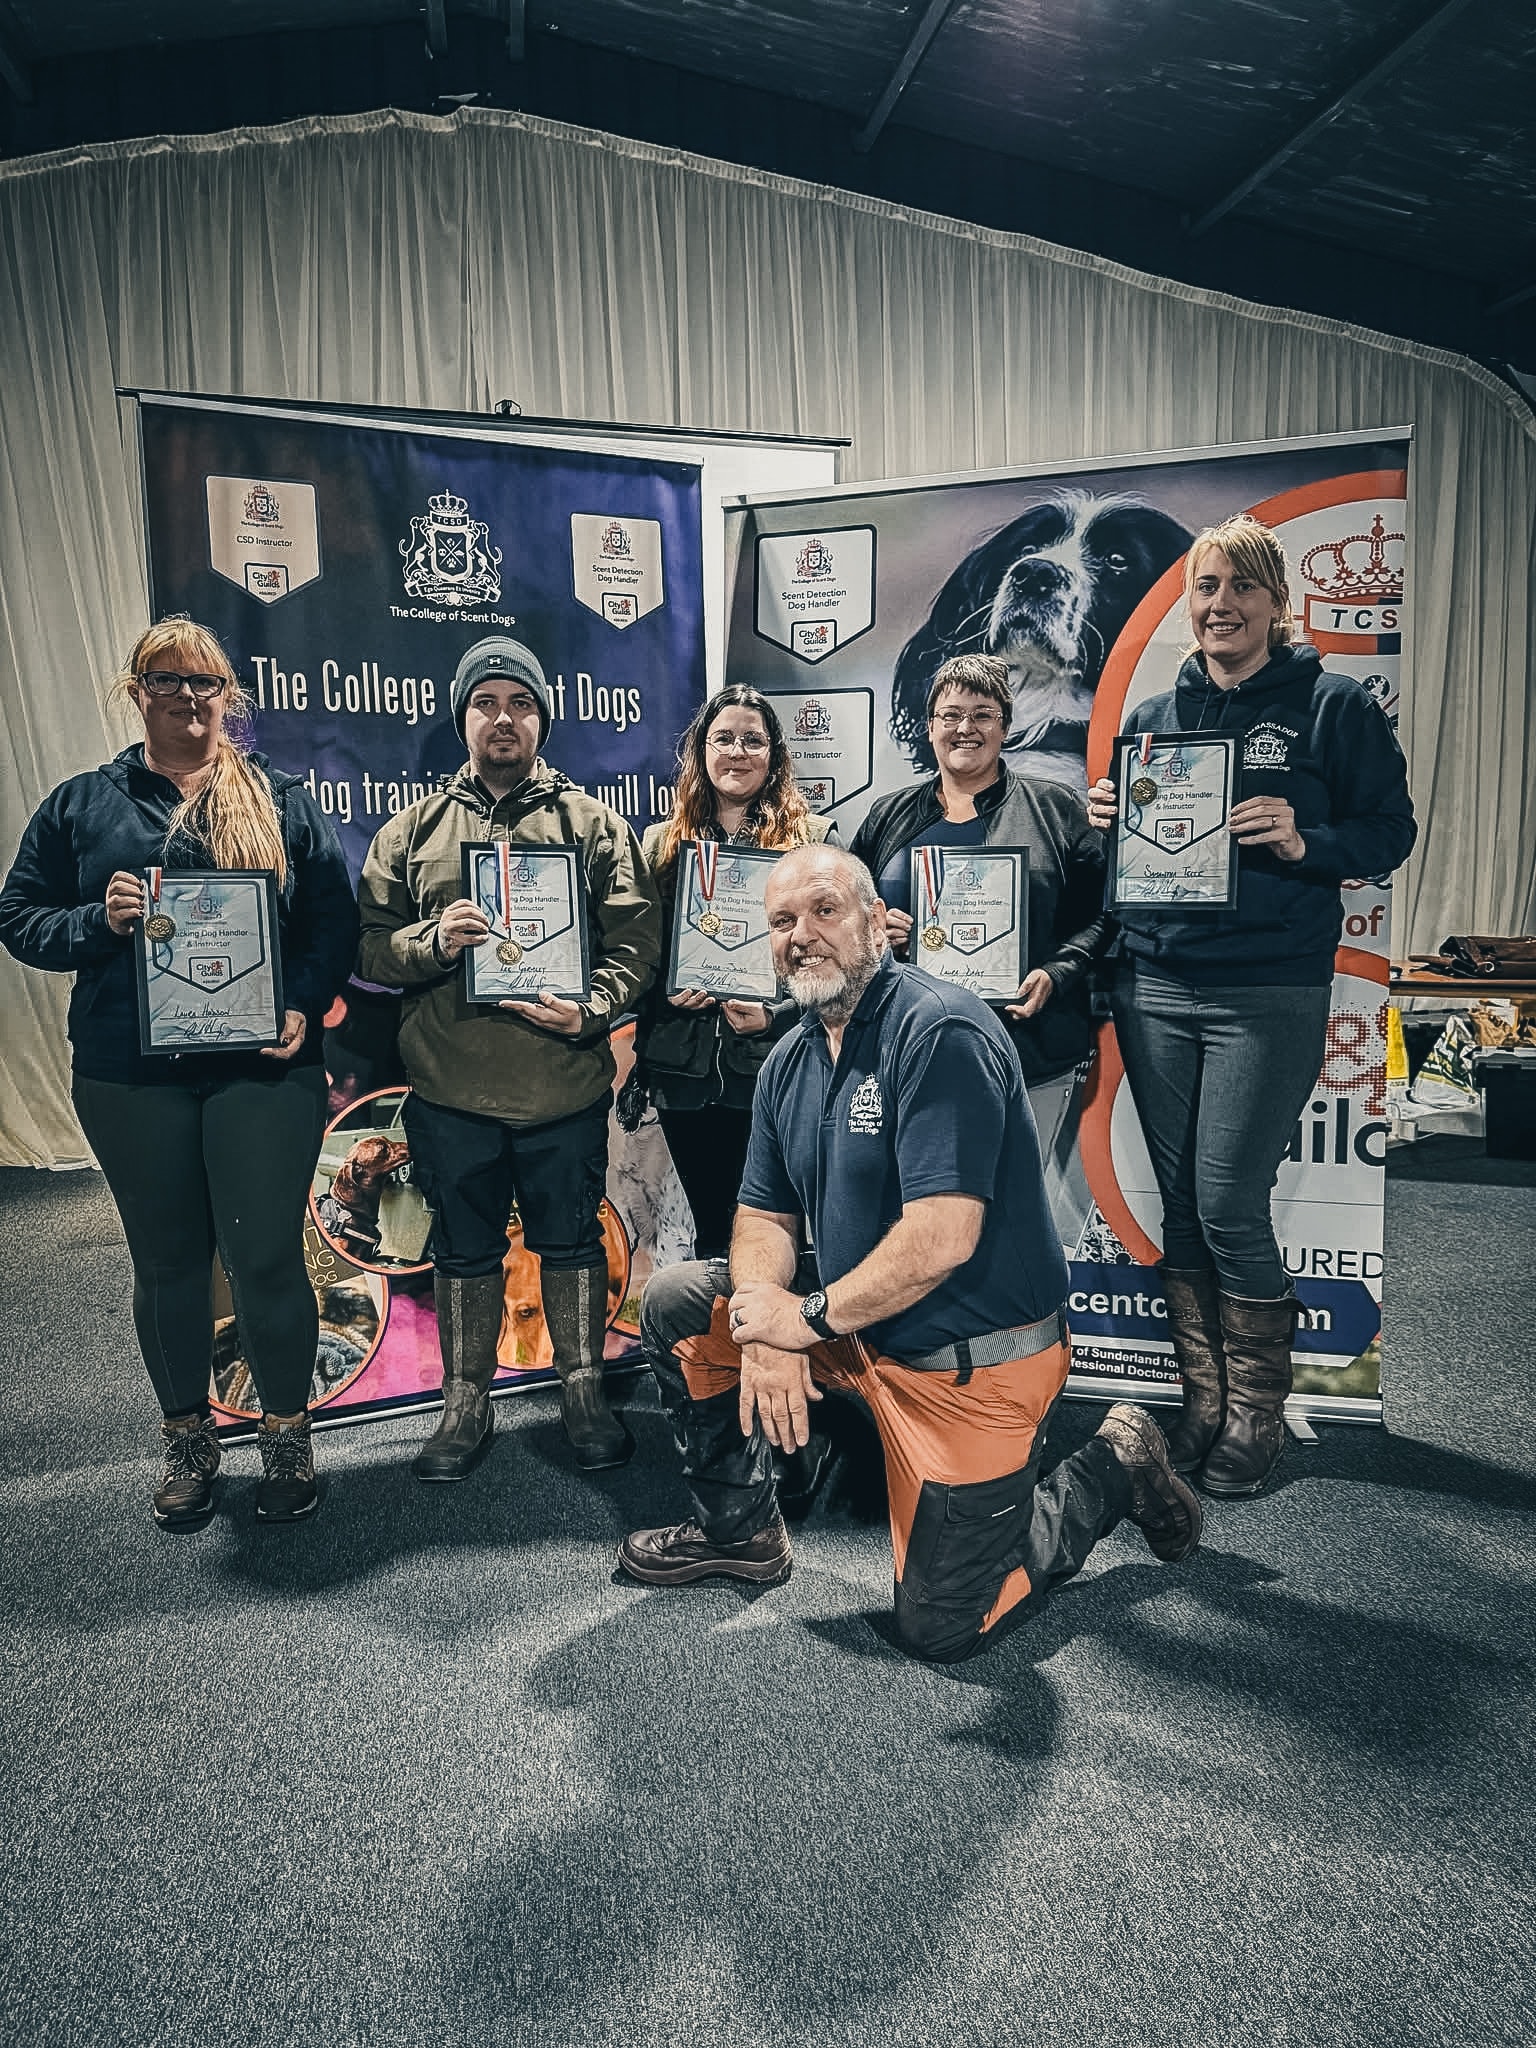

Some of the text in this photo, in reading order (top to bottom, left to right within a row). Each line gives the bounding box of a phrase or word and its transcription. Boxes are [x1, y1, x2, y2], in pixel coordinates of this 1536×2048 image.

[236, 536, 292, 547] CSD Instructor
[598, 574, 638, 584] Dog Handler
[782, 588, 846, 600] Scent Detection
[788, 599, 840, 610] Dog Handler
[390, 606, 516, 627] The College of Scent Dogs
[804, 637, 828, 645] Guilds
[250, 656, 308, 711] The
[322, 659, 436, 726] College
[577, 672, 642, 732] Dogs
[1346, 904, 1385, 936] of
[857, 1120, 876, 1128] College
[1077, 1347, 1088, 1356] of
[1092, 1347, 1160, 1366] Sunderland
[1128, 1366, 1184, 1381] Doctorat
